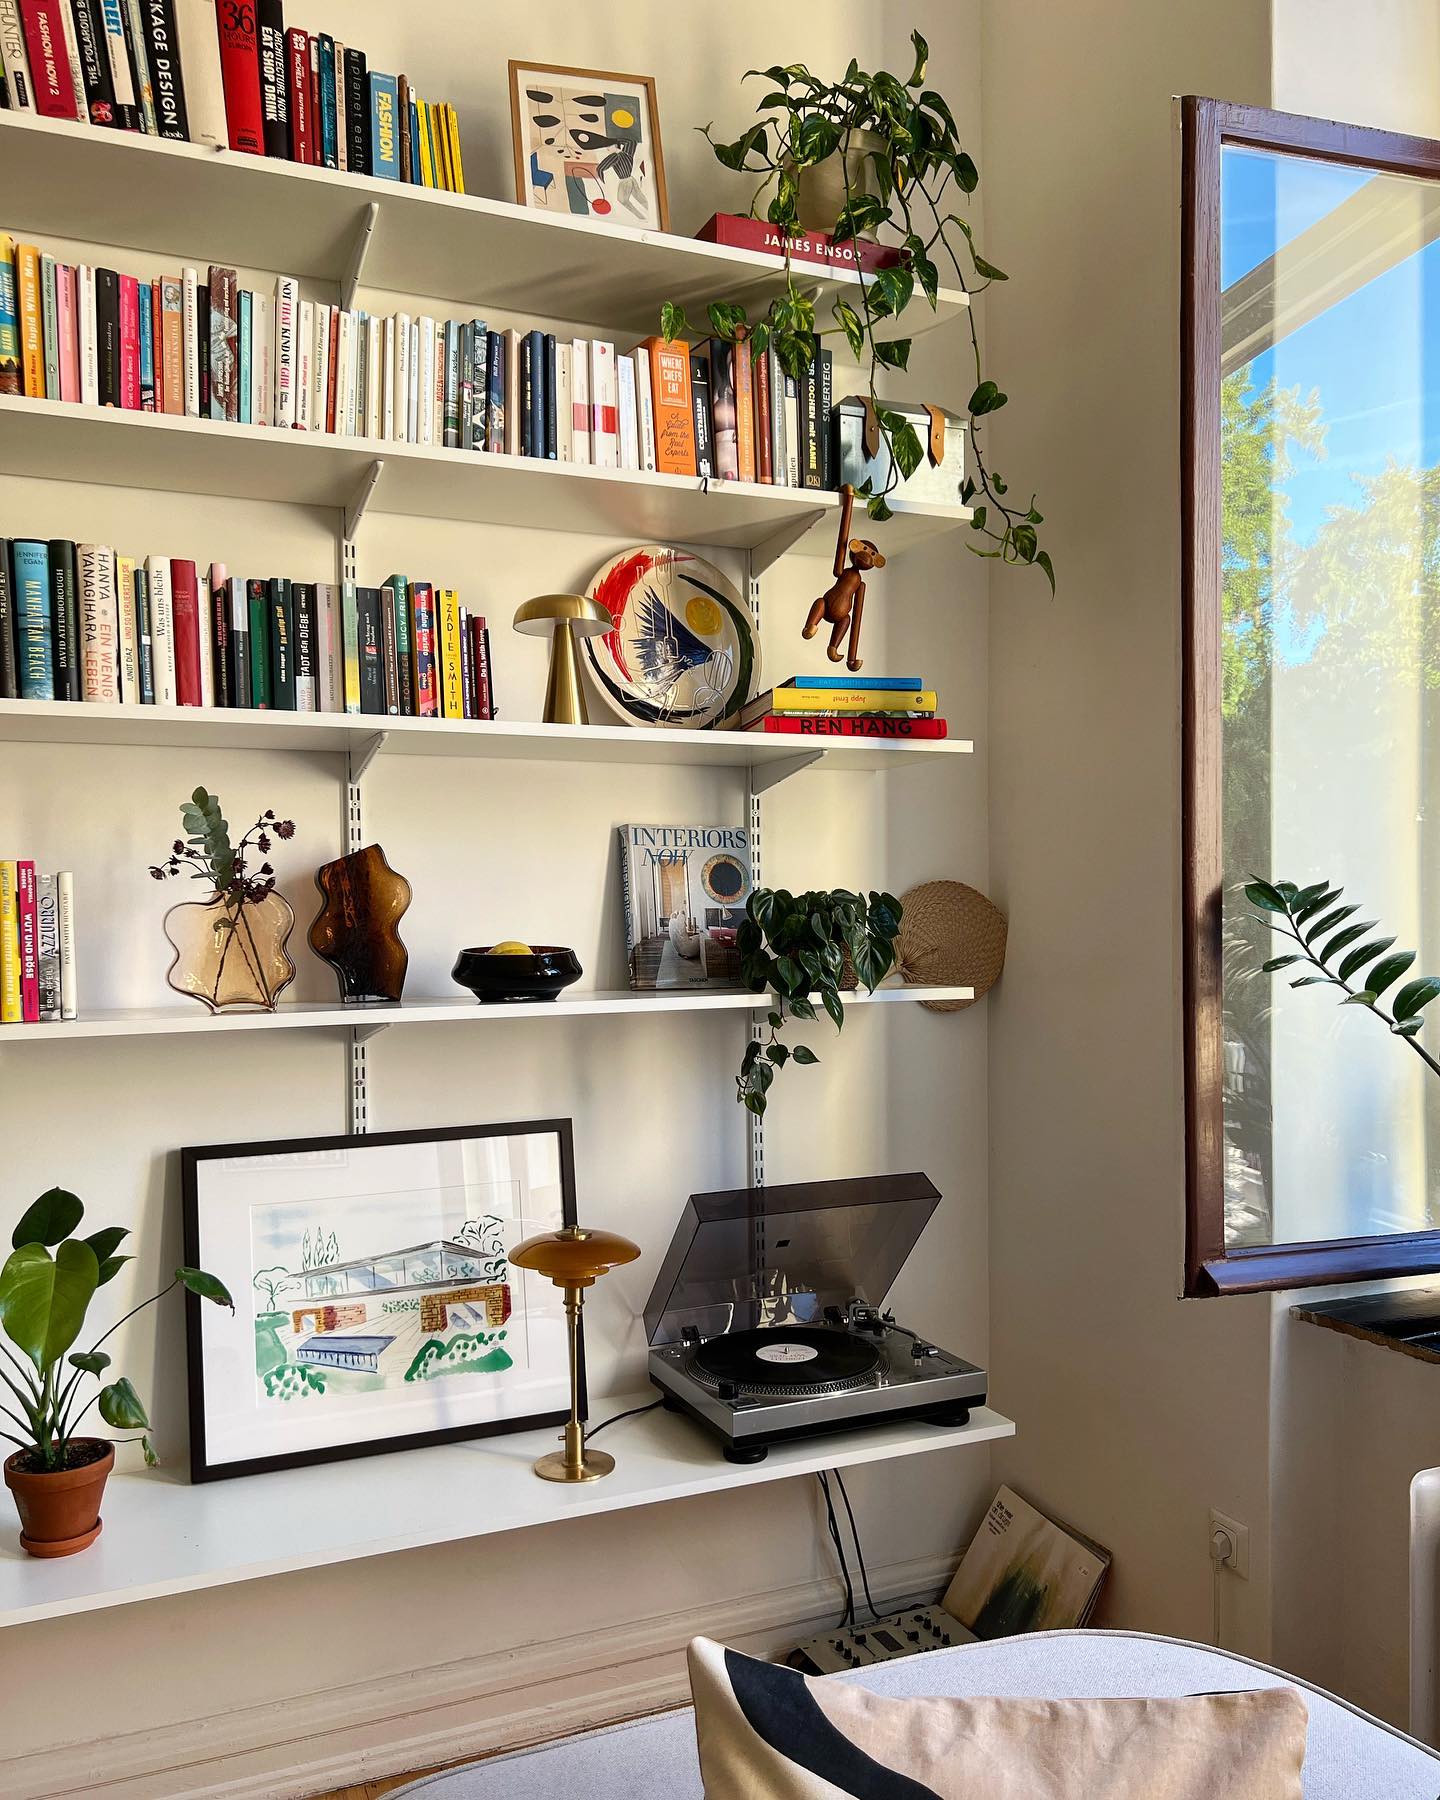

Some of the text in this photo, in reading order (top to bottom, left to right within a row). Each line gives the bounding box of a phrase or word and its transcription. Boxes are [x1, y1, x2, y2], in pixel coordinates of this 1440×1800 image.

[222, 2, 256, 35] 36
[37, 11, 60, 96] FASHION NOW 2
[79, 13, 96, 69] POLAROID
[89, 69, 100, 87] THE
[261, 26, 279, 122] EAT SHOP DRINK
[273, 30, 288, 123] ARCHITECTURE NOW!
[294, 53, 303, 88] MICHELIN
[156, 58, 179, 126] DESIGN
[351, 66, 366, 170] planet earth
[377, 91, 394, 162] FASHION
[24, 254, 34, 278] Men
[25, 279, 37, 313] White
[27, 316, 38, 351] Stupid
[280, 280, 292, 389] NOT THAT KIND OF GIRL
[661, 356, 684, 370] WHERE
[128, 382, 136, 392] Op
[662, 370, 684, 383] CHEFS
[667, 382, 680, 394] EAT
[822, 362, 831, 423] SAUERTEIG
[661, 429, 680, 440] from
[808, 378, 818, 470] KOCHEN mit JAMIE
[664, 448, 690, 458] Experts
[16, 551, 49, 560] JENNIFER
[23, 558, 44, 566] EGAN
[122, 574, 130, 583] DU
[154, 569, 164, 596] bleibt
[123, 583, 132, 616] VERLIERST
[398, 581, 406, 617] FRICKE
[25, 580, 46, 679] MANHATTAN BEACH
[56, 568, 68, 668] DAVID ATTENBOROUGH
[81, 551, 98, 697] YANAGIHARA LEBEN
[98, 553, 114, 698] HANYA EIN WENIG
[124, 616, 132, 626] SO
[157, 617, 165, 637] Was
[300, 613, 309, 639] DIEBE
[420, 590, 430, 656] Bernardine Evaristo
[124, 626, 132, 640] UND
[399, 620, 408, 646] LUCY
[478, 627, 486, 645] love.
[301, 640, 309, 653] DER
[445, 603, 459, 711] ZADIE SMITH
[480, 668, 487, 678] Do
[833, 695, 866, 704] Jupp Ernst
[801, 719, 913, 735] REN HANG
[632, 827, 747, 849] INTERIORS
[640, 848, 695, 868] NOW
[23, 913, 34, 935] WUT
[40, 896, 57, 959] AZZURRO
[24, 936, 35, 957] UND
[25, 956, 35, 979] BÖSE
[46, 984, 55, 1009] ERIC
